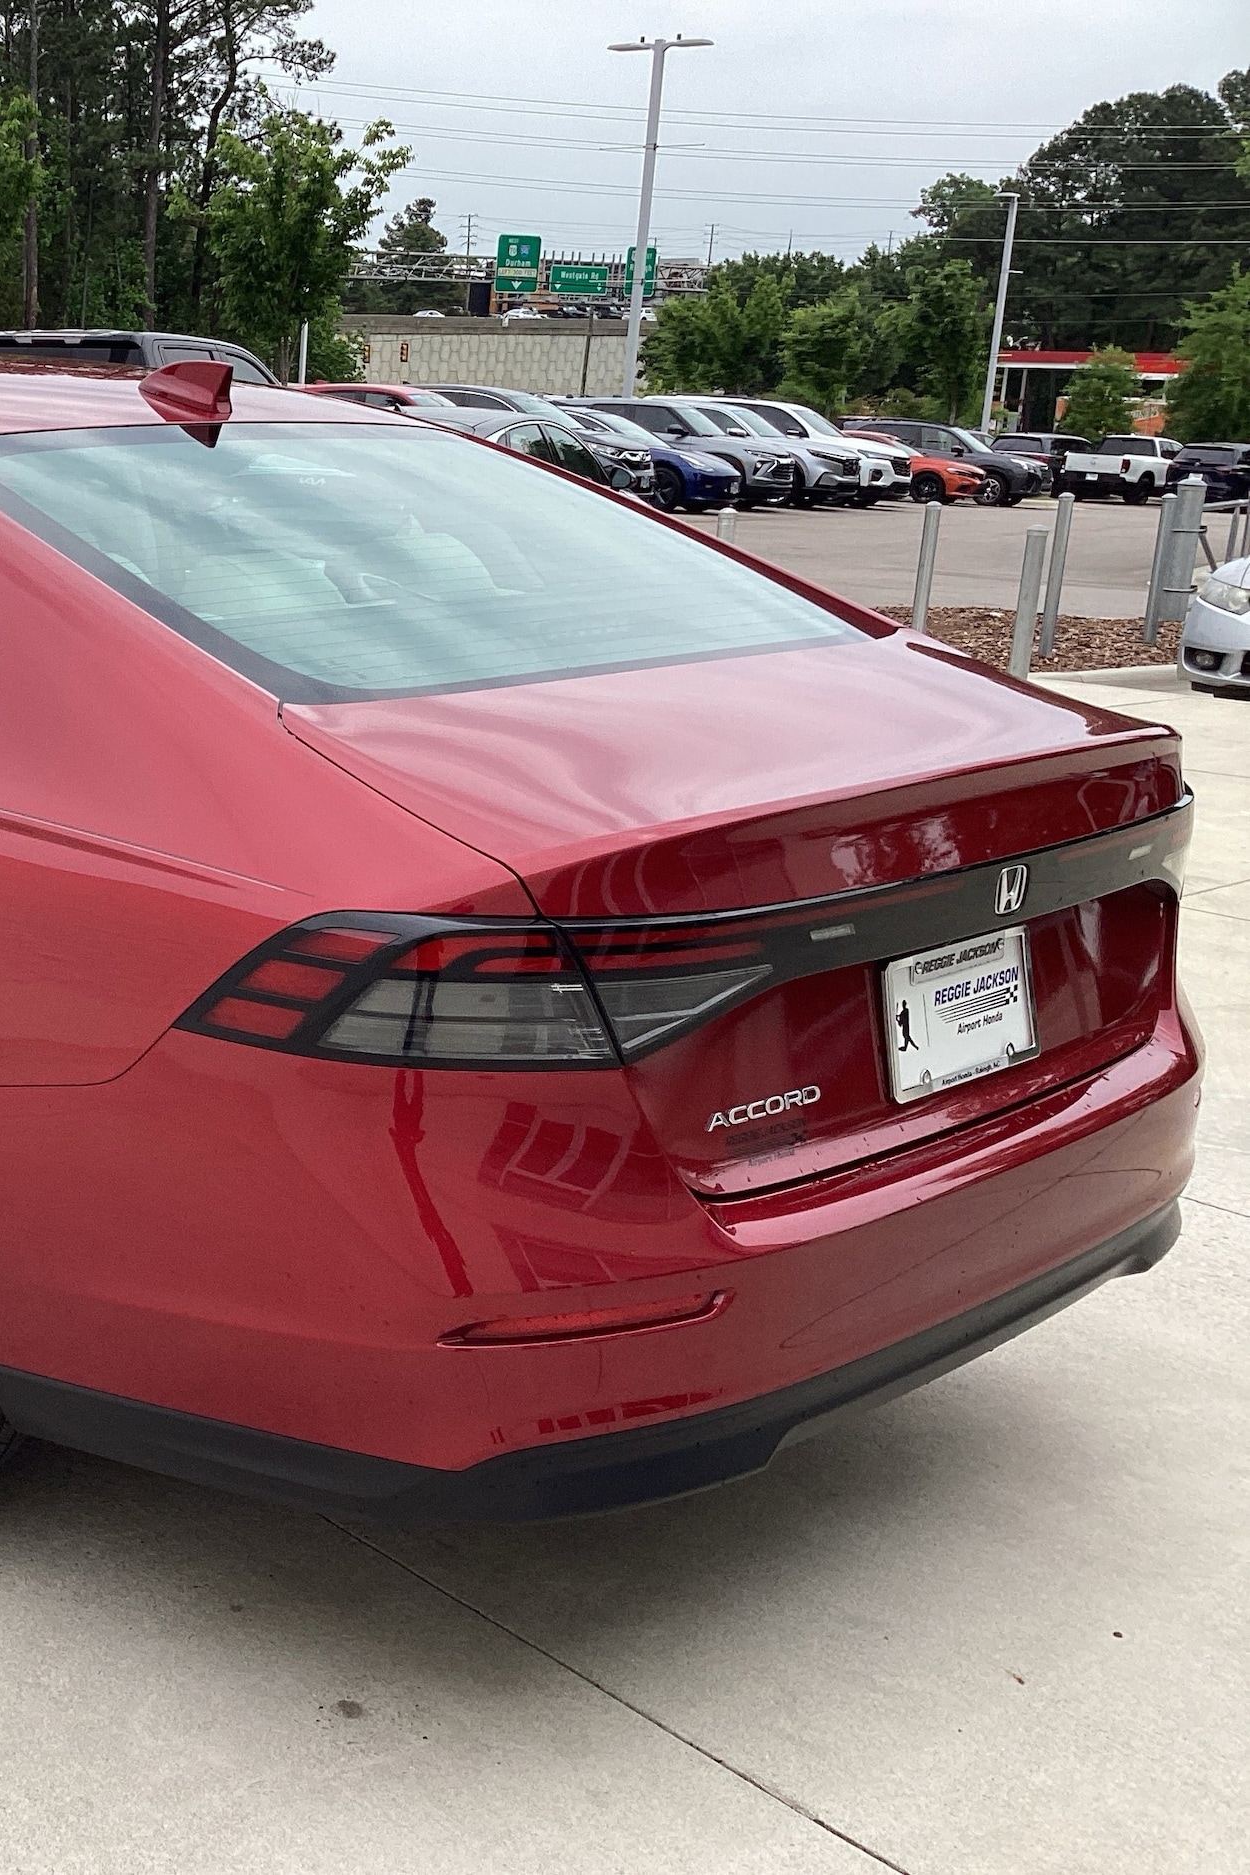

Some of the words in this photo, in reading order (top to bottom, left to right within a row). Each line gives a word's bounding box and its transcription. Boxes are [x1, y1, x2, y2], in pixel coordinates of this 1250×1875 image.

[505, 258, 531, 267] Durham
[561, 271, 589, 281] Westgate
[922, 953, 956, 974] REGGIE
[956, 942, 997, 965] JACKSON
[934, 981, 971, 1006] REGGIE
[973, 966, 1019, 993] JACKSON
[957, 1020, 982, 1035] Airport
[982, 1011, 1003, 1026] Honda
[704, 1085, 821, 1132] ACCORD
